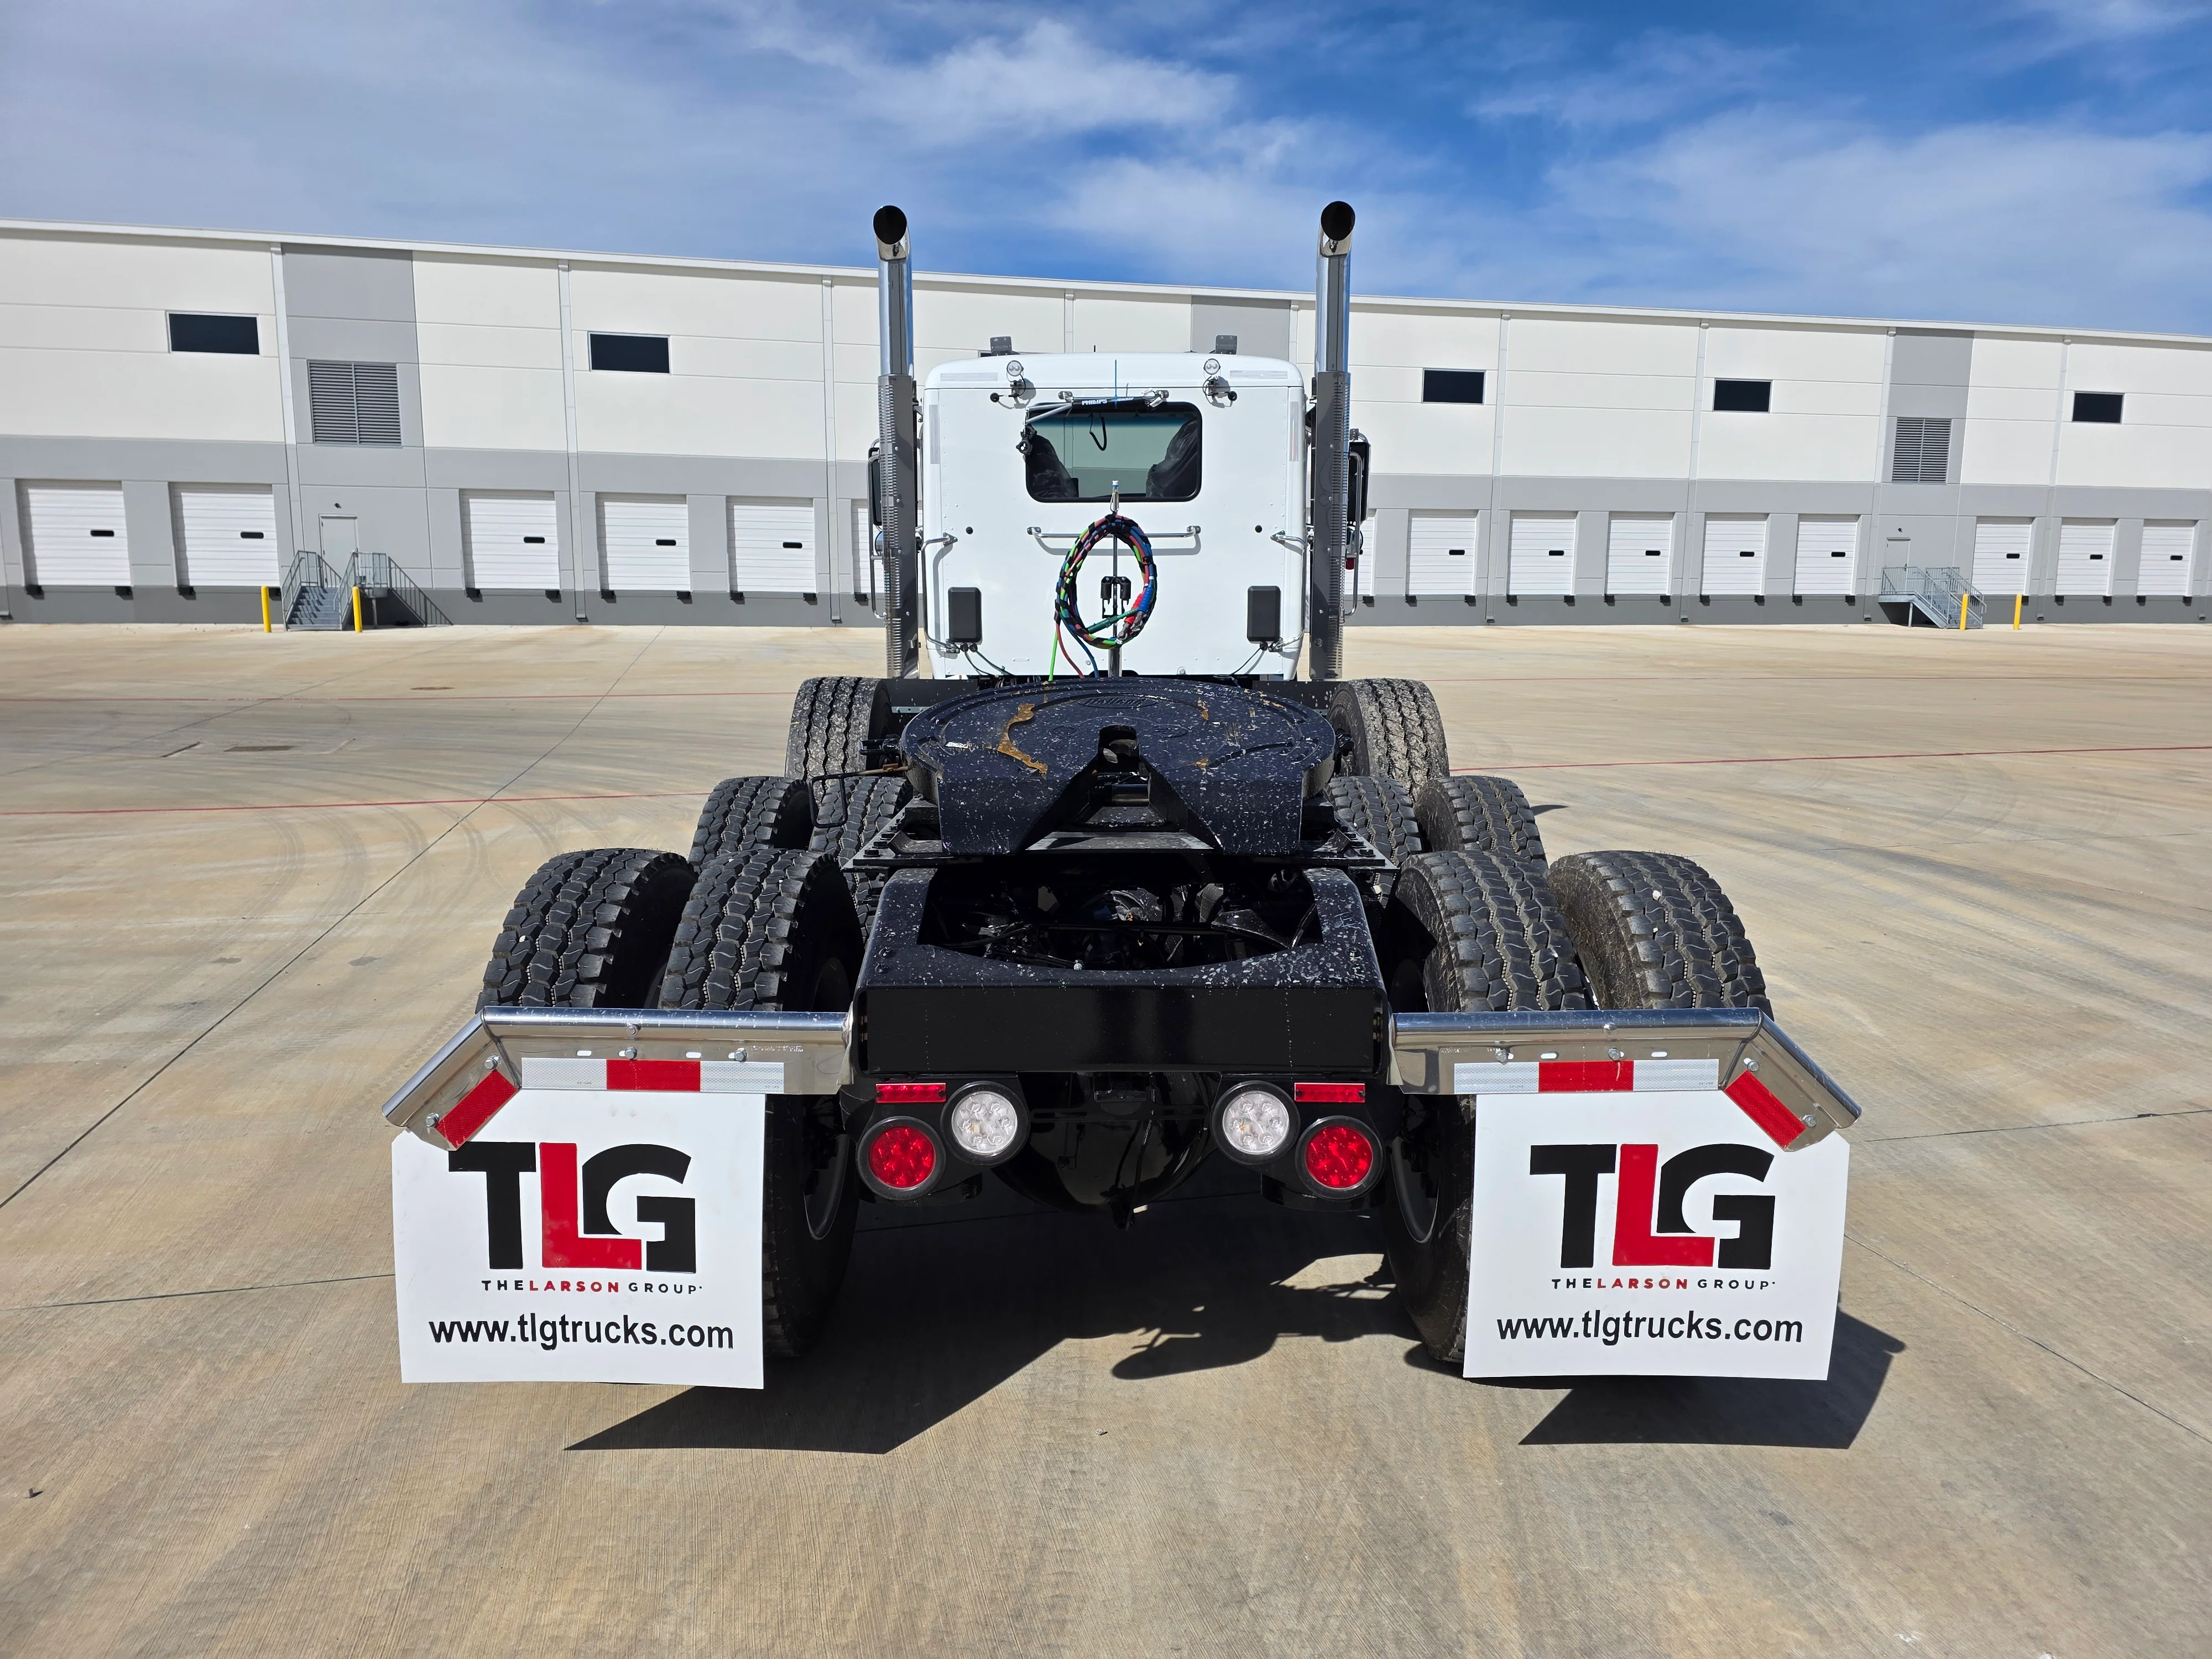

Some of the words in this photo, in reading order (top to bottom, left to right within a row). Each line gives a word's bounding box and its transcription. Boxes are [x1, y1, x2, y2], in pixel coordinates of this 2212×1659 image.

[448, 1142, 696, 1274] TLG
[1530, 1143, 1776, 1270] TLG
[628, 1282, 697, 1295] GROUP
[1697, 1279, 1770, 1290] GROUP
[428, 1312, 734, 1351] www.tlgtrucks.com
[1496, 1310, 1803, 1346] www.tlgtrucks.com
